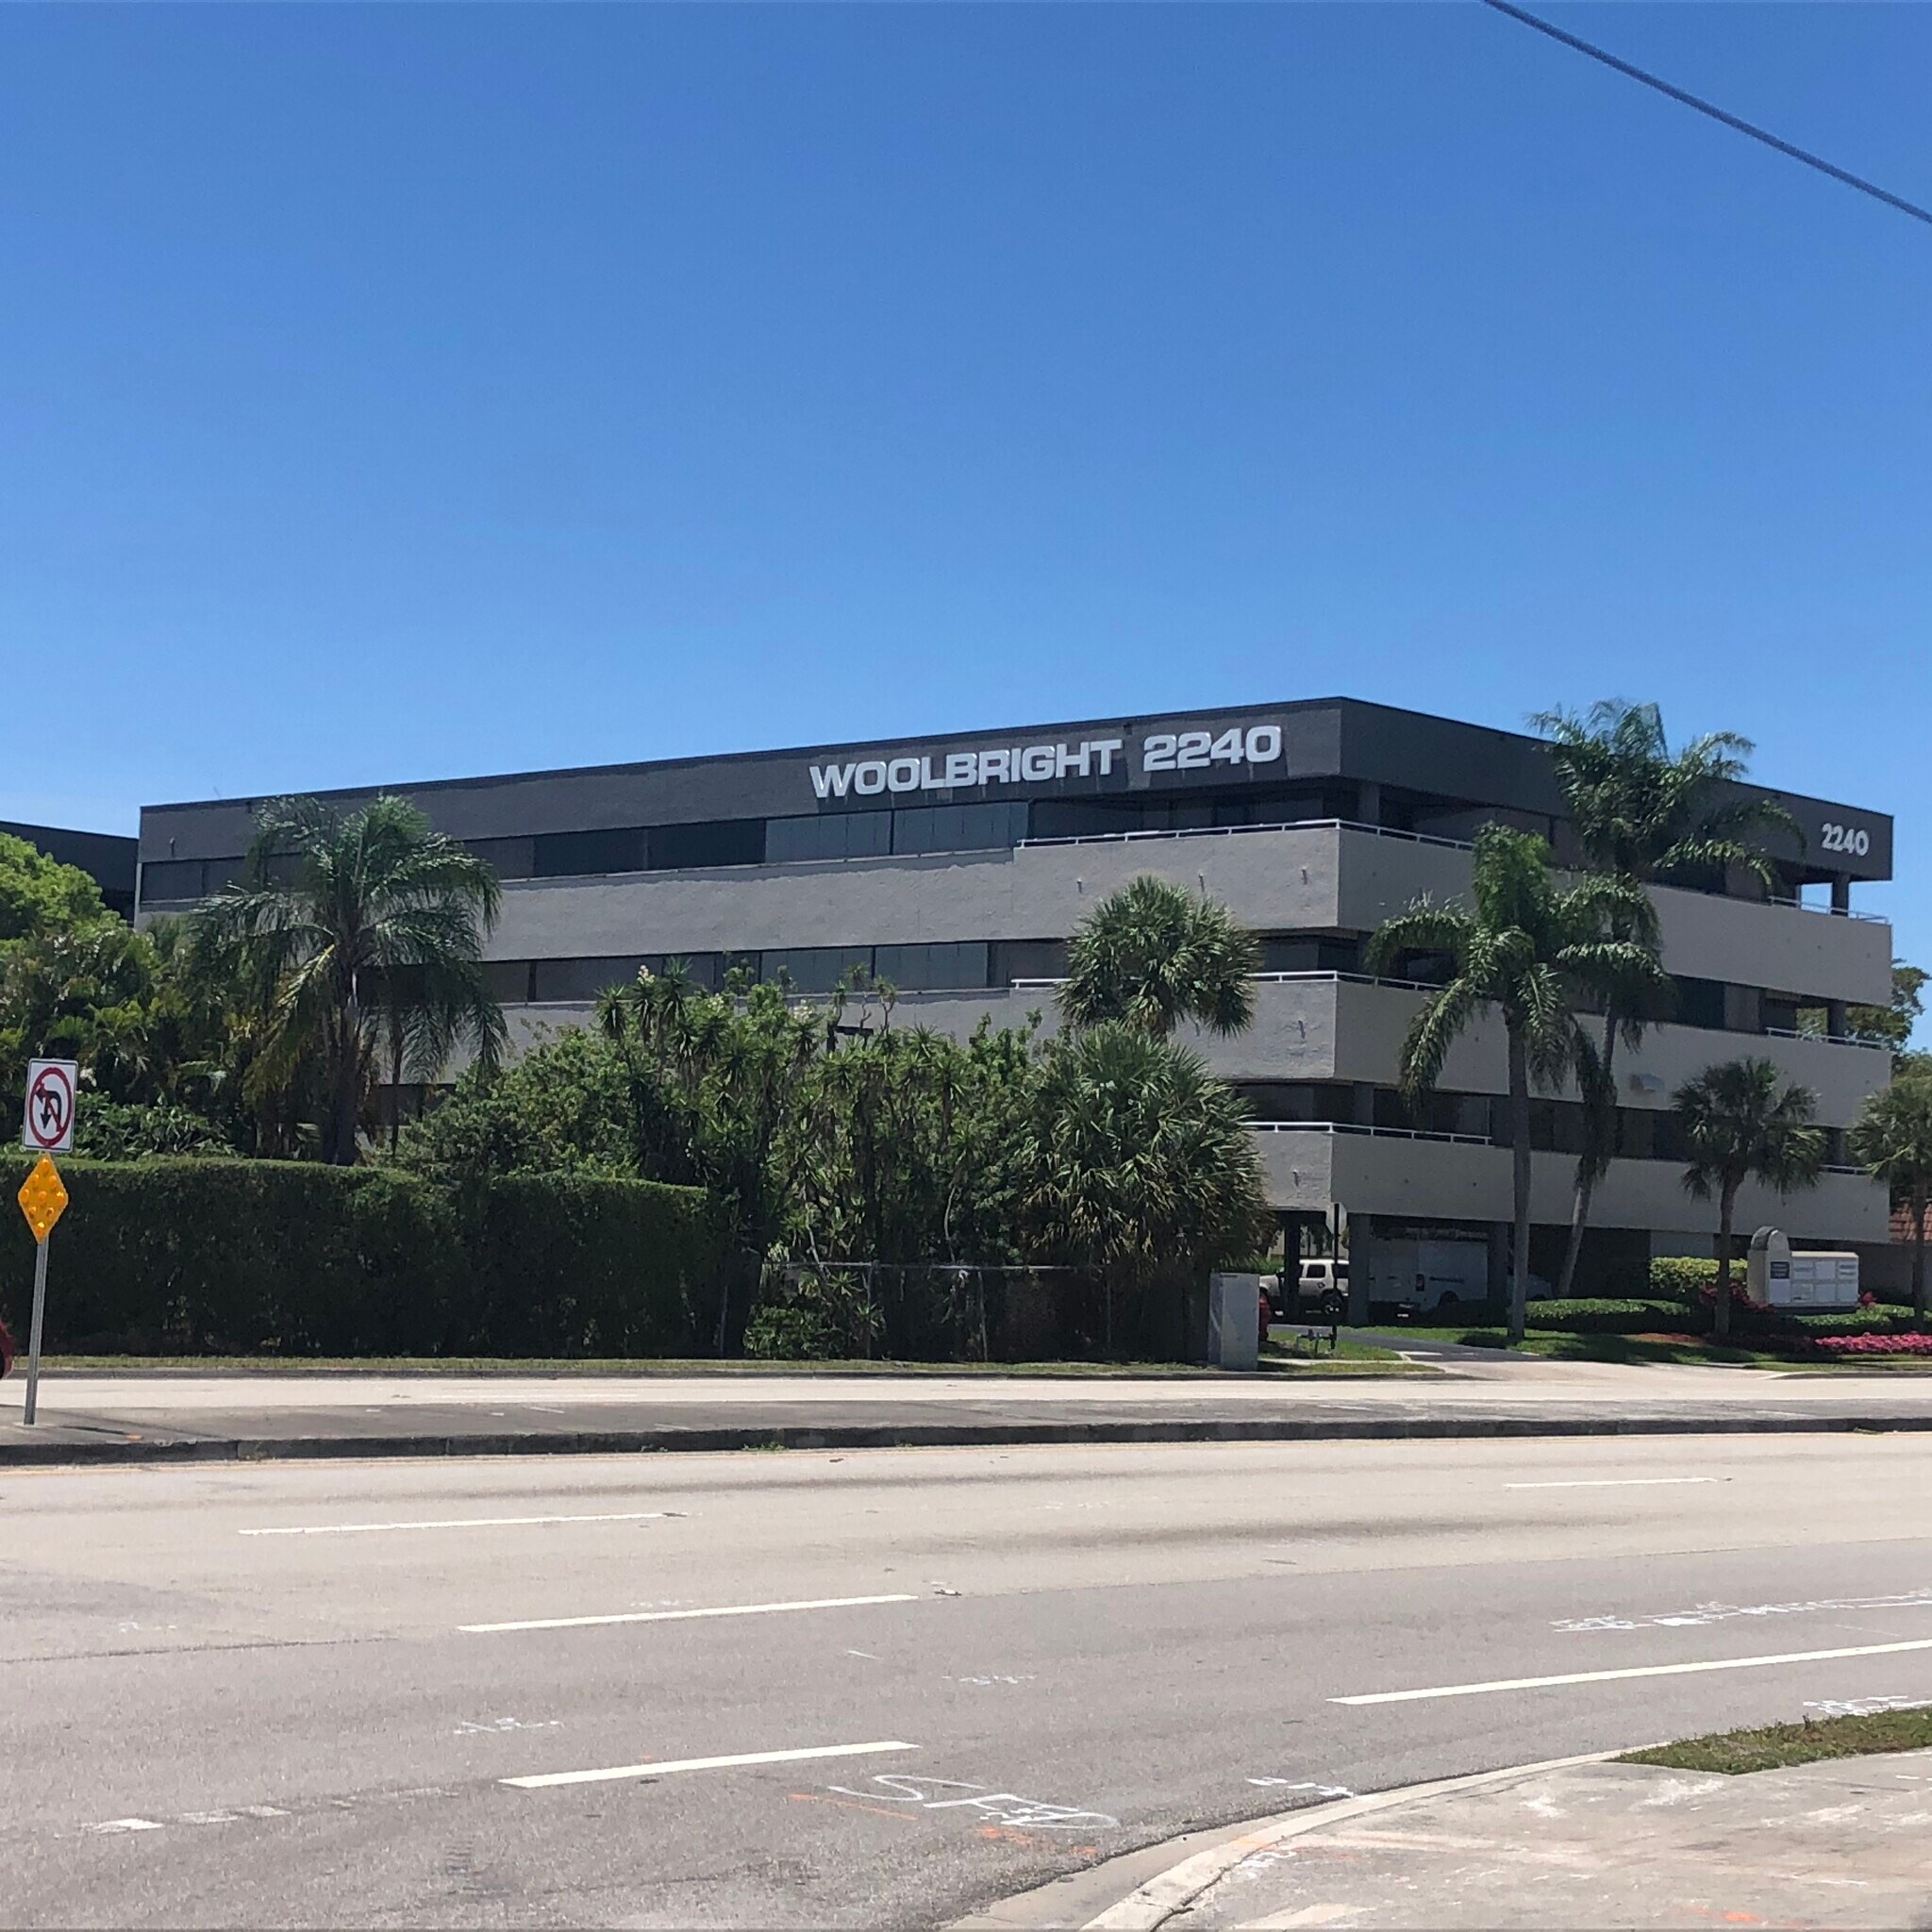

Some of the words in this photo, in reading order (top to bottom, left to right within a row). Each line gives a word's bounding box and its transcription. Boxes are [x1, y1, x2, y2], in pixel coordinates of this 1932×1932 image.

[809, 739, 1123, 799] WOOLBRIGHT
[1142, 725, 1282, 772] 2240
[1822, 823, 1870, 857] 2240
